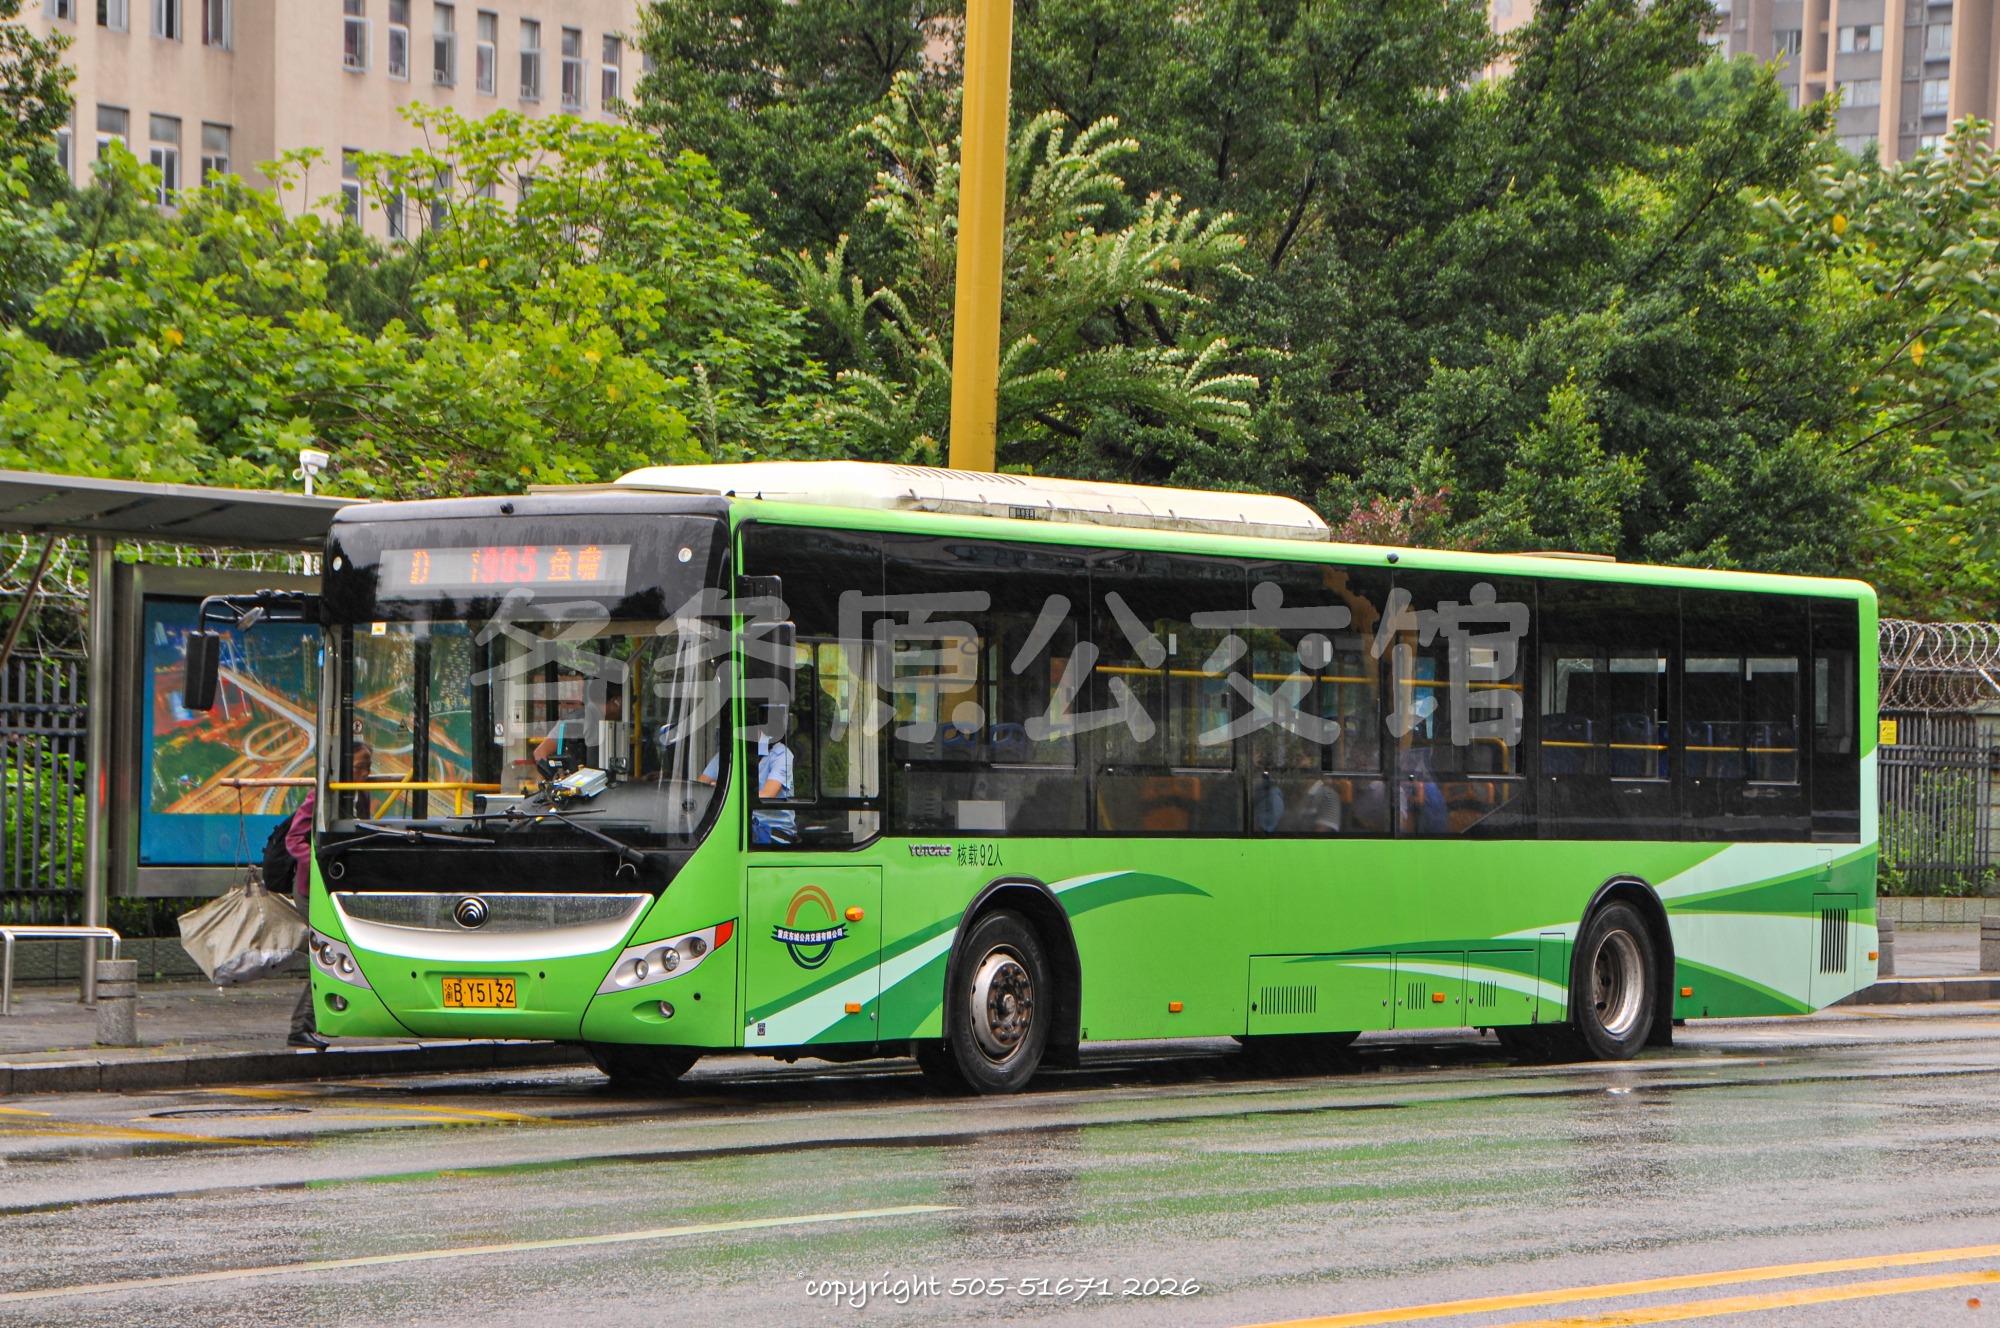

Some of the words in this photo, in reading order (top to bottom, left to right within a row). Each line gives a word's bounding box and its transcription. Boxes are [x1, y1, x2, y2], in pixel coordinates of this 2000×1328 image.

[908, 843, 953, 857] YUTONG
[957, 844, 1003, 867] 核载92人
